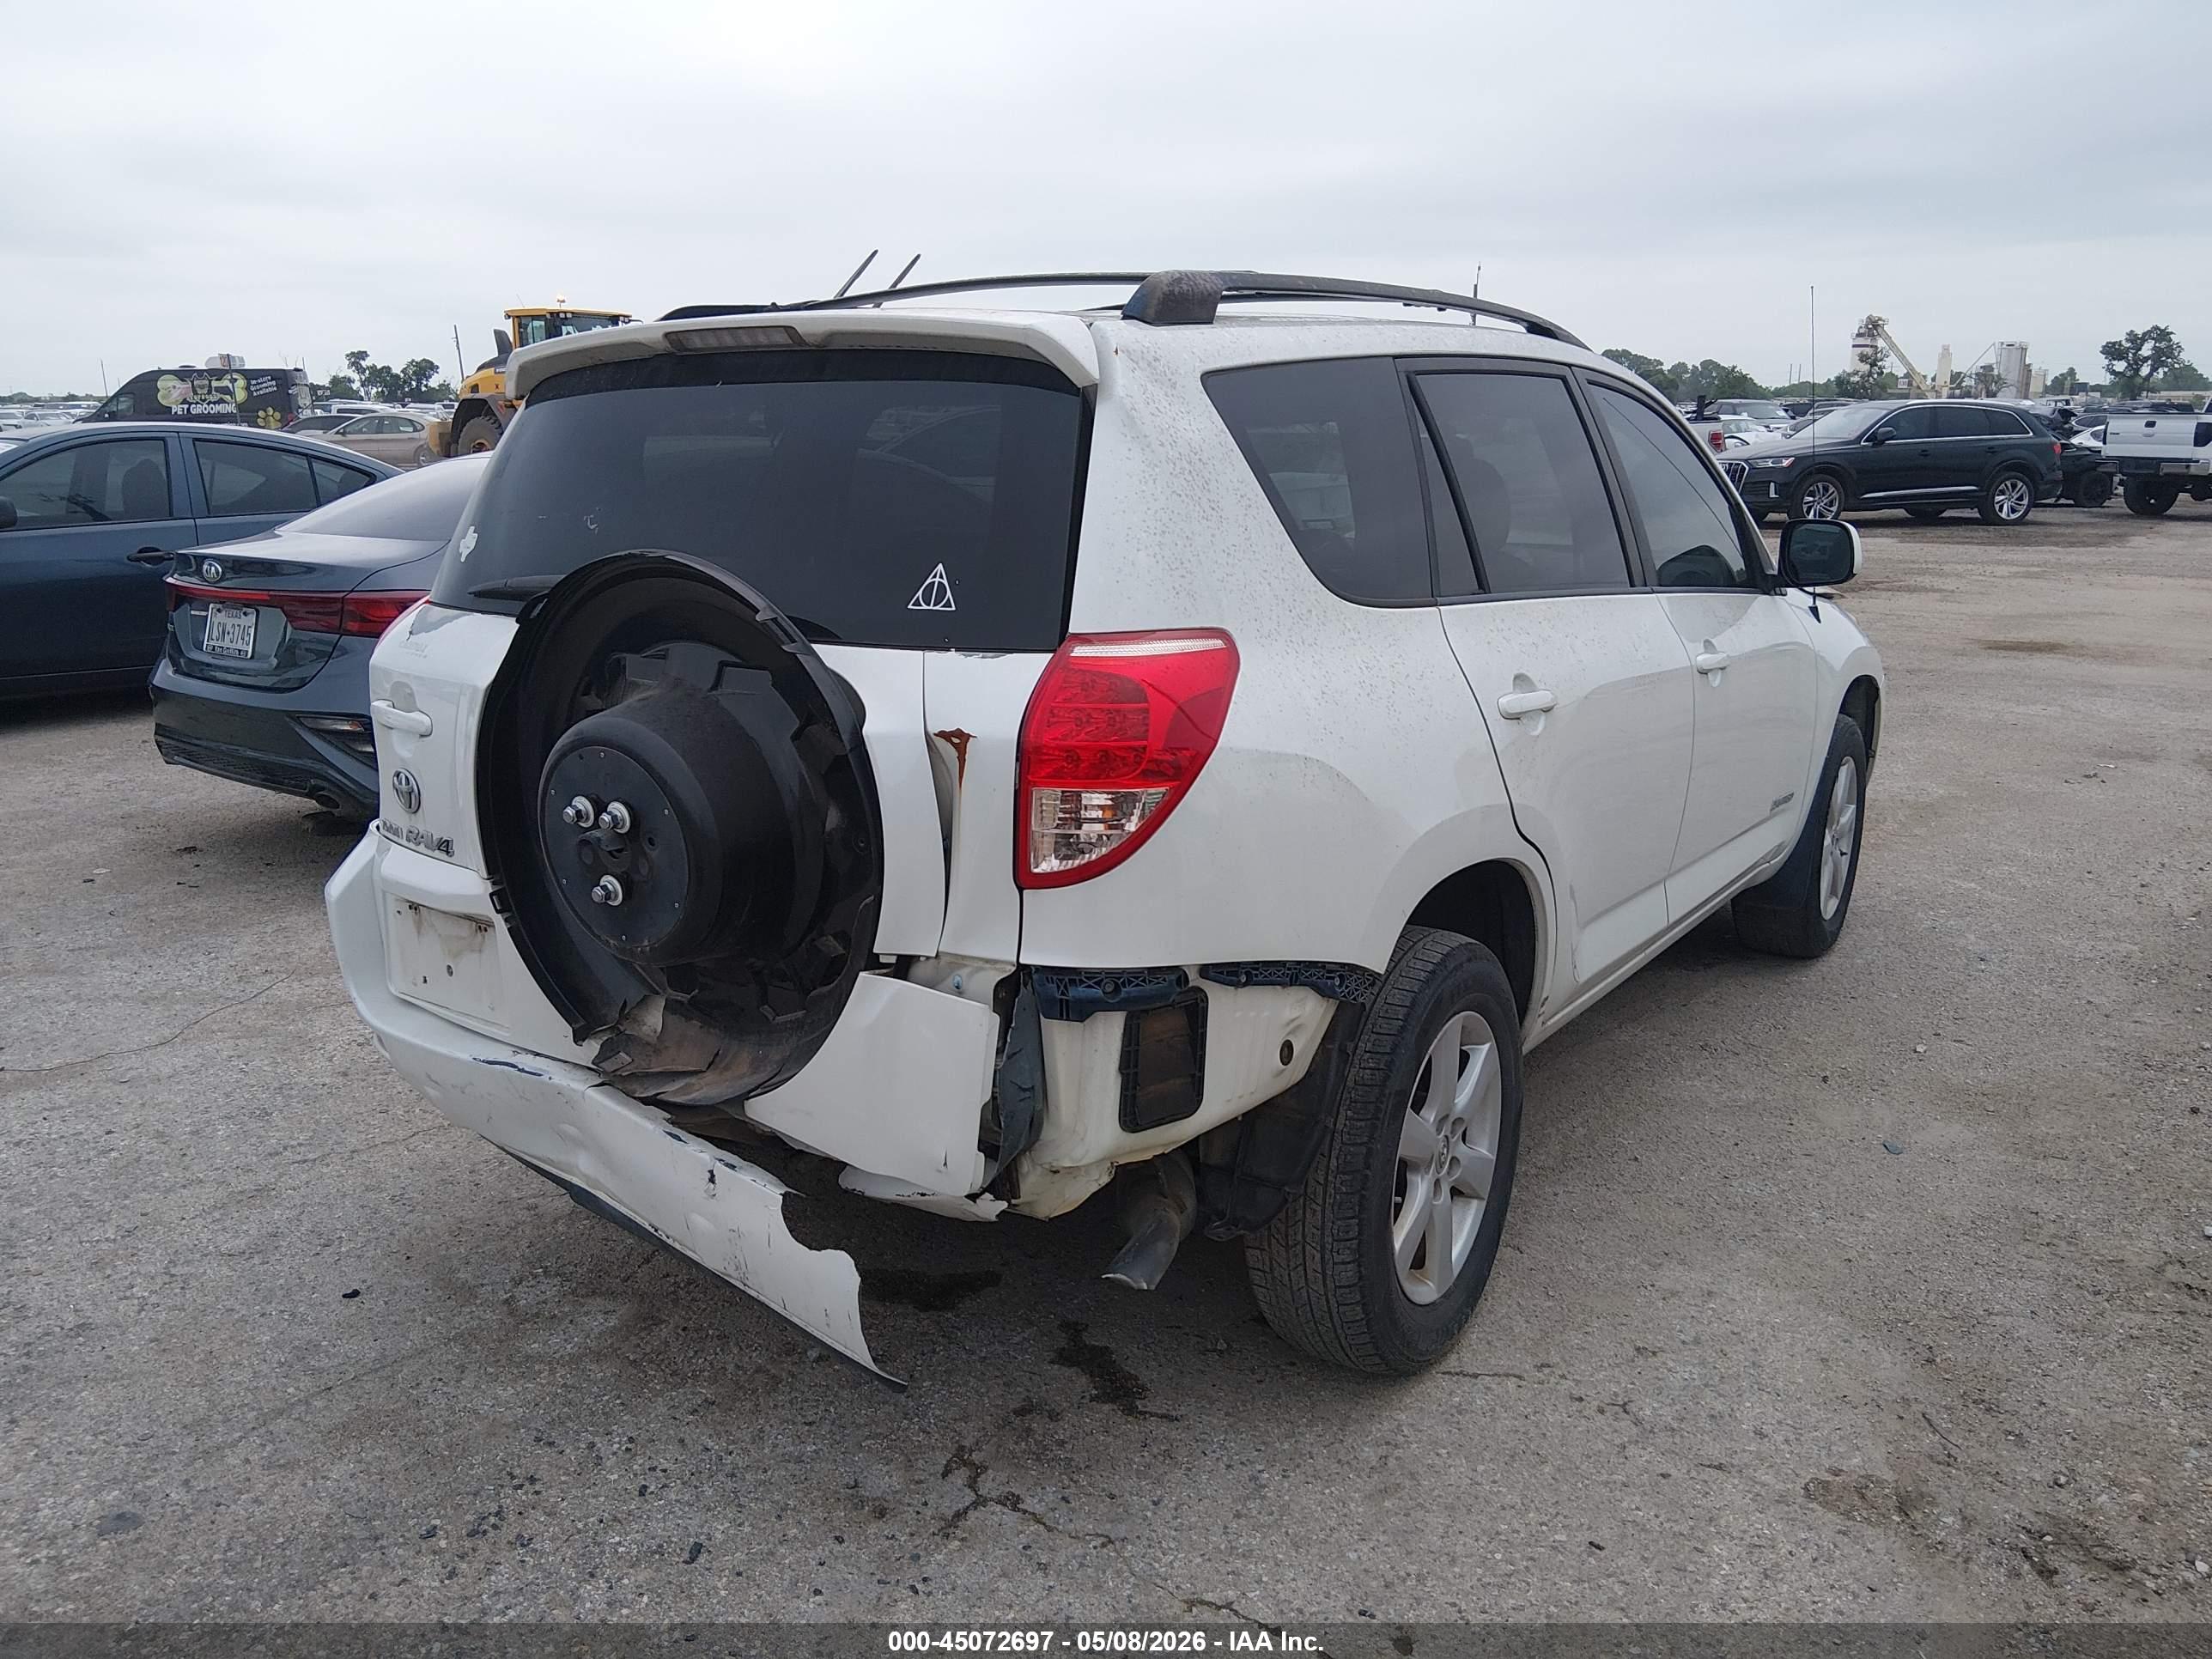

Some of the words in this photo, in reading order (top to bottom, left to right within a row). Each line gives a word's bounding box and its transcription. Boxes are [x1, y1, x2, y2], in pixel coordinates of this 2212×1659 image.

[250, 375, 271, 385] In-store
[250, 380, 276, 392] Grooming
[252, 386, 277, 397] Available
[171, 404, 189, 415] PET
[190, 403, 237, 414] GROOMING
[224, 611, 241, 619] TEXAS
[405, 825, 454, 857] RAV4
